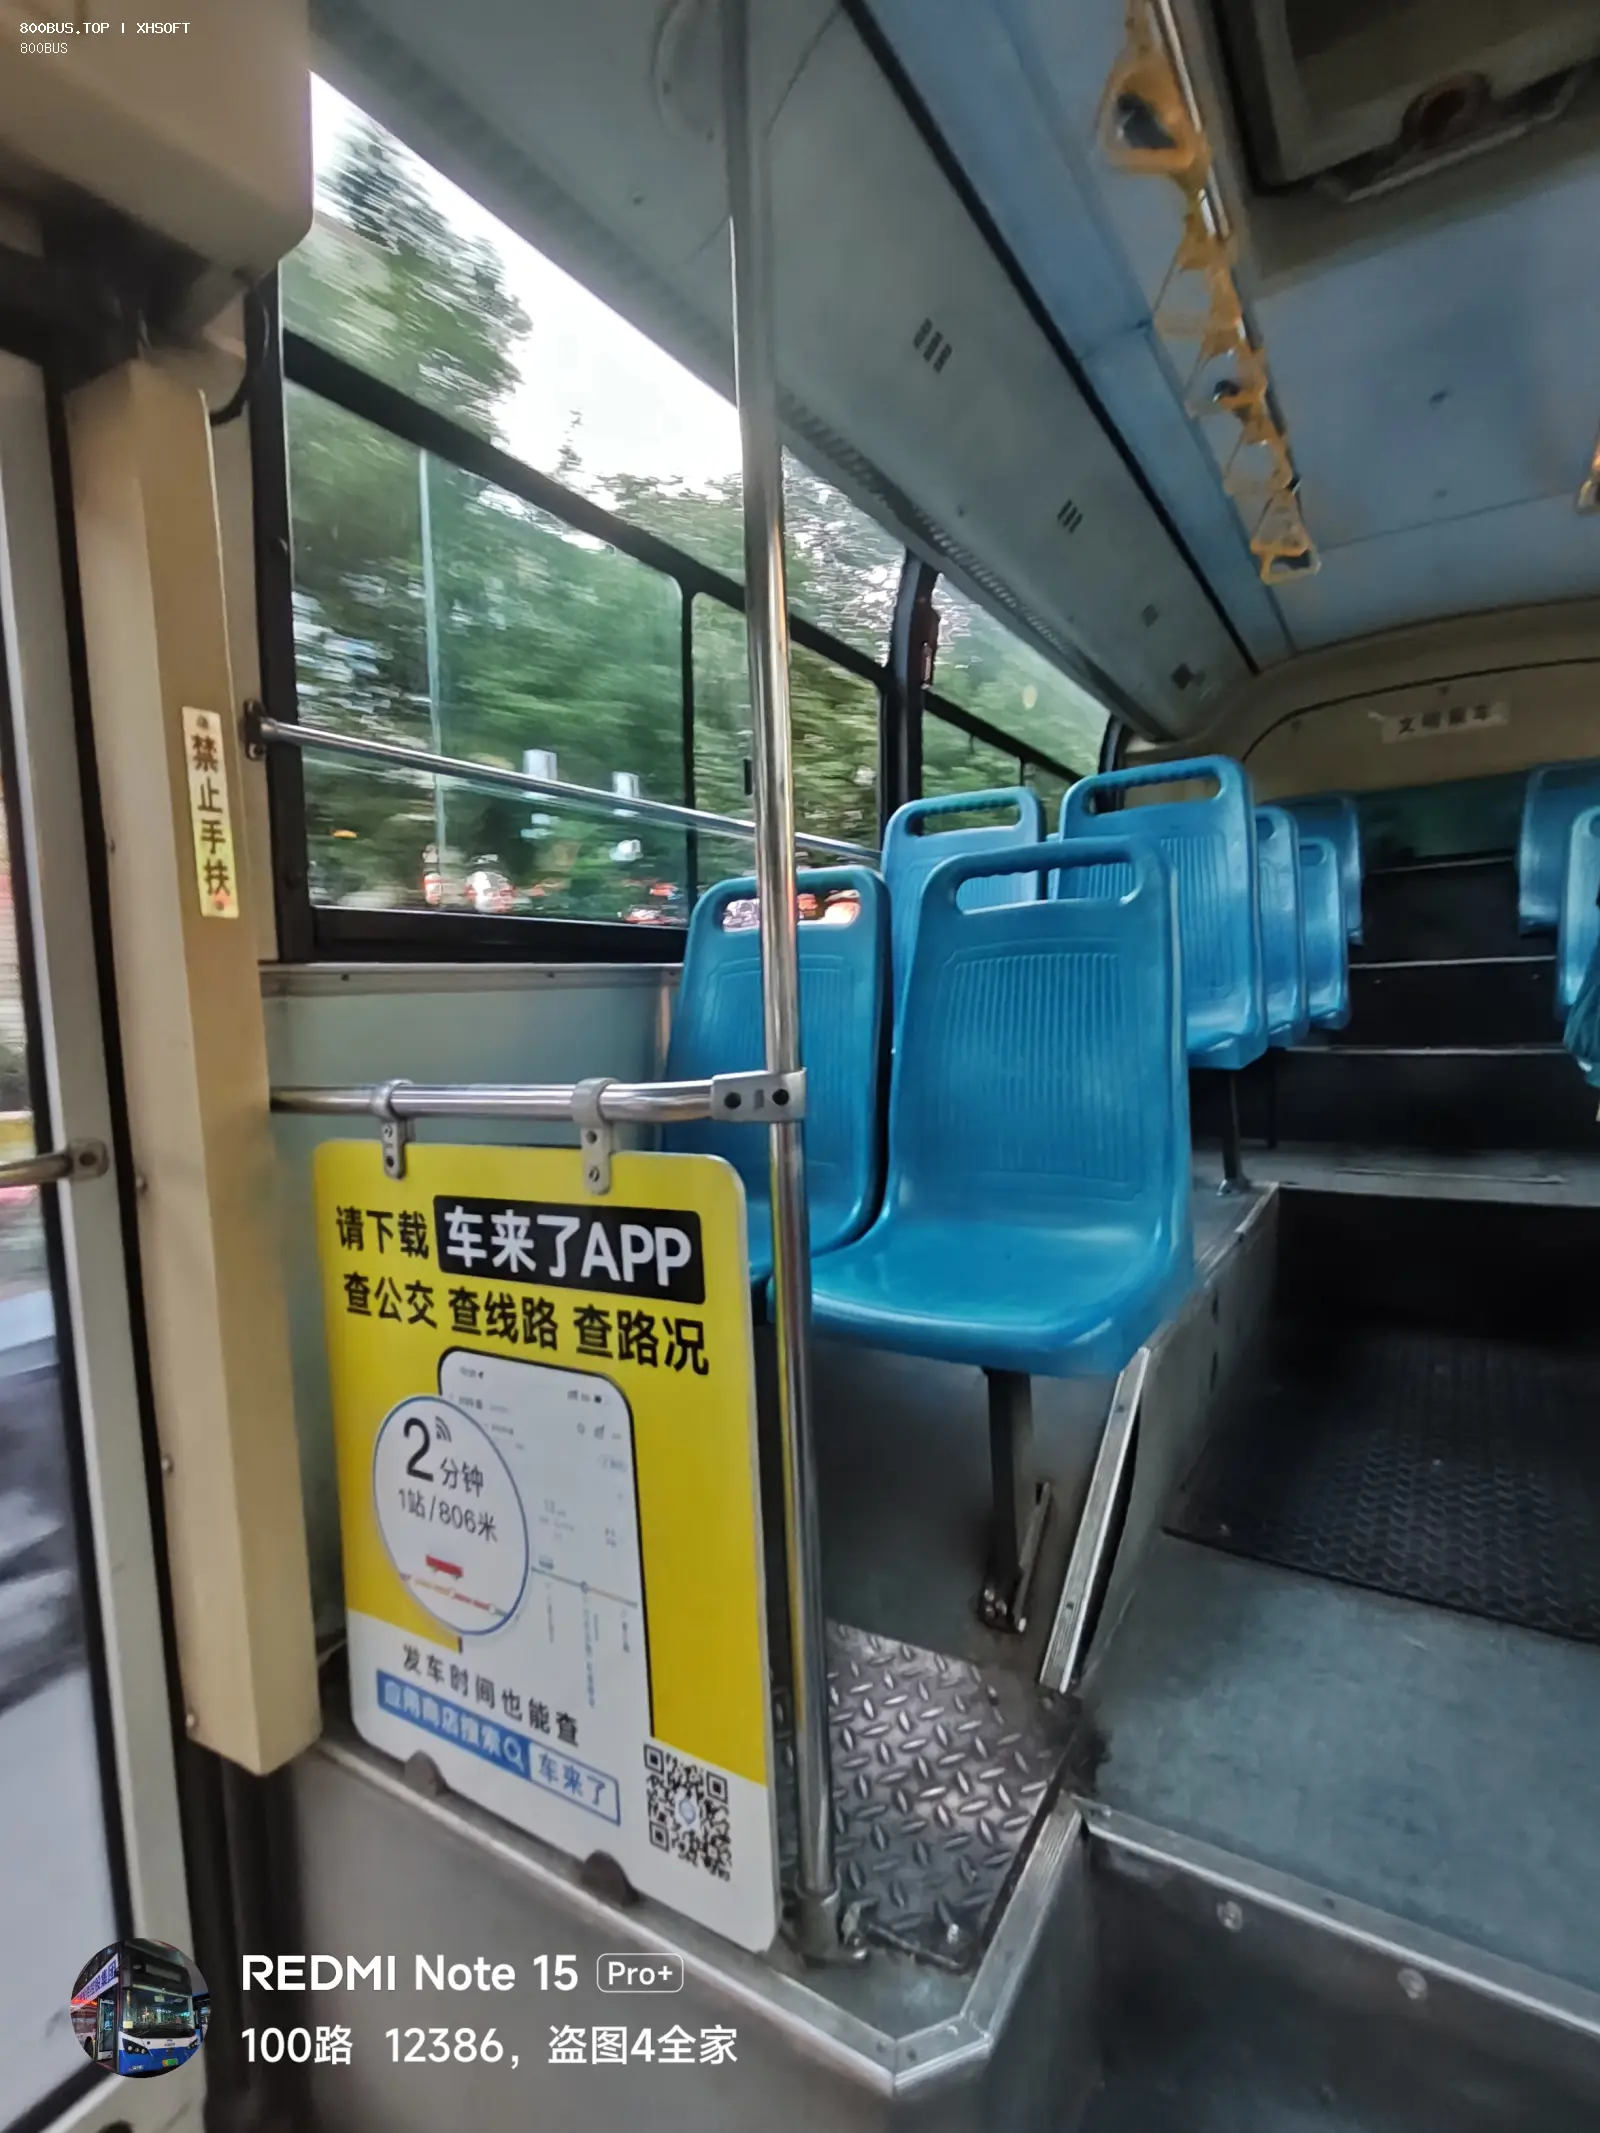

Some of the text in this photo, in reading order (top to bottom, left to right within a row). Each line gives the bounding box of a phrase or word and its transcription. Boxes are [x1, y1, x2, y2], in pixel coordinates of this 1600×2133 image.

[190, 733, 232, 897] 禁止手扶
[335, 1205, 692, 1287] 请下载 车来了APP
[343, 1271, 710, 1377] 查公交 查线路 查路况
[397, 1487, 499, 1543] 1站/806米
[402, 1644, 580, 1748] 发车时间也能查
[538, 1753, 607, 1806] 车来了
